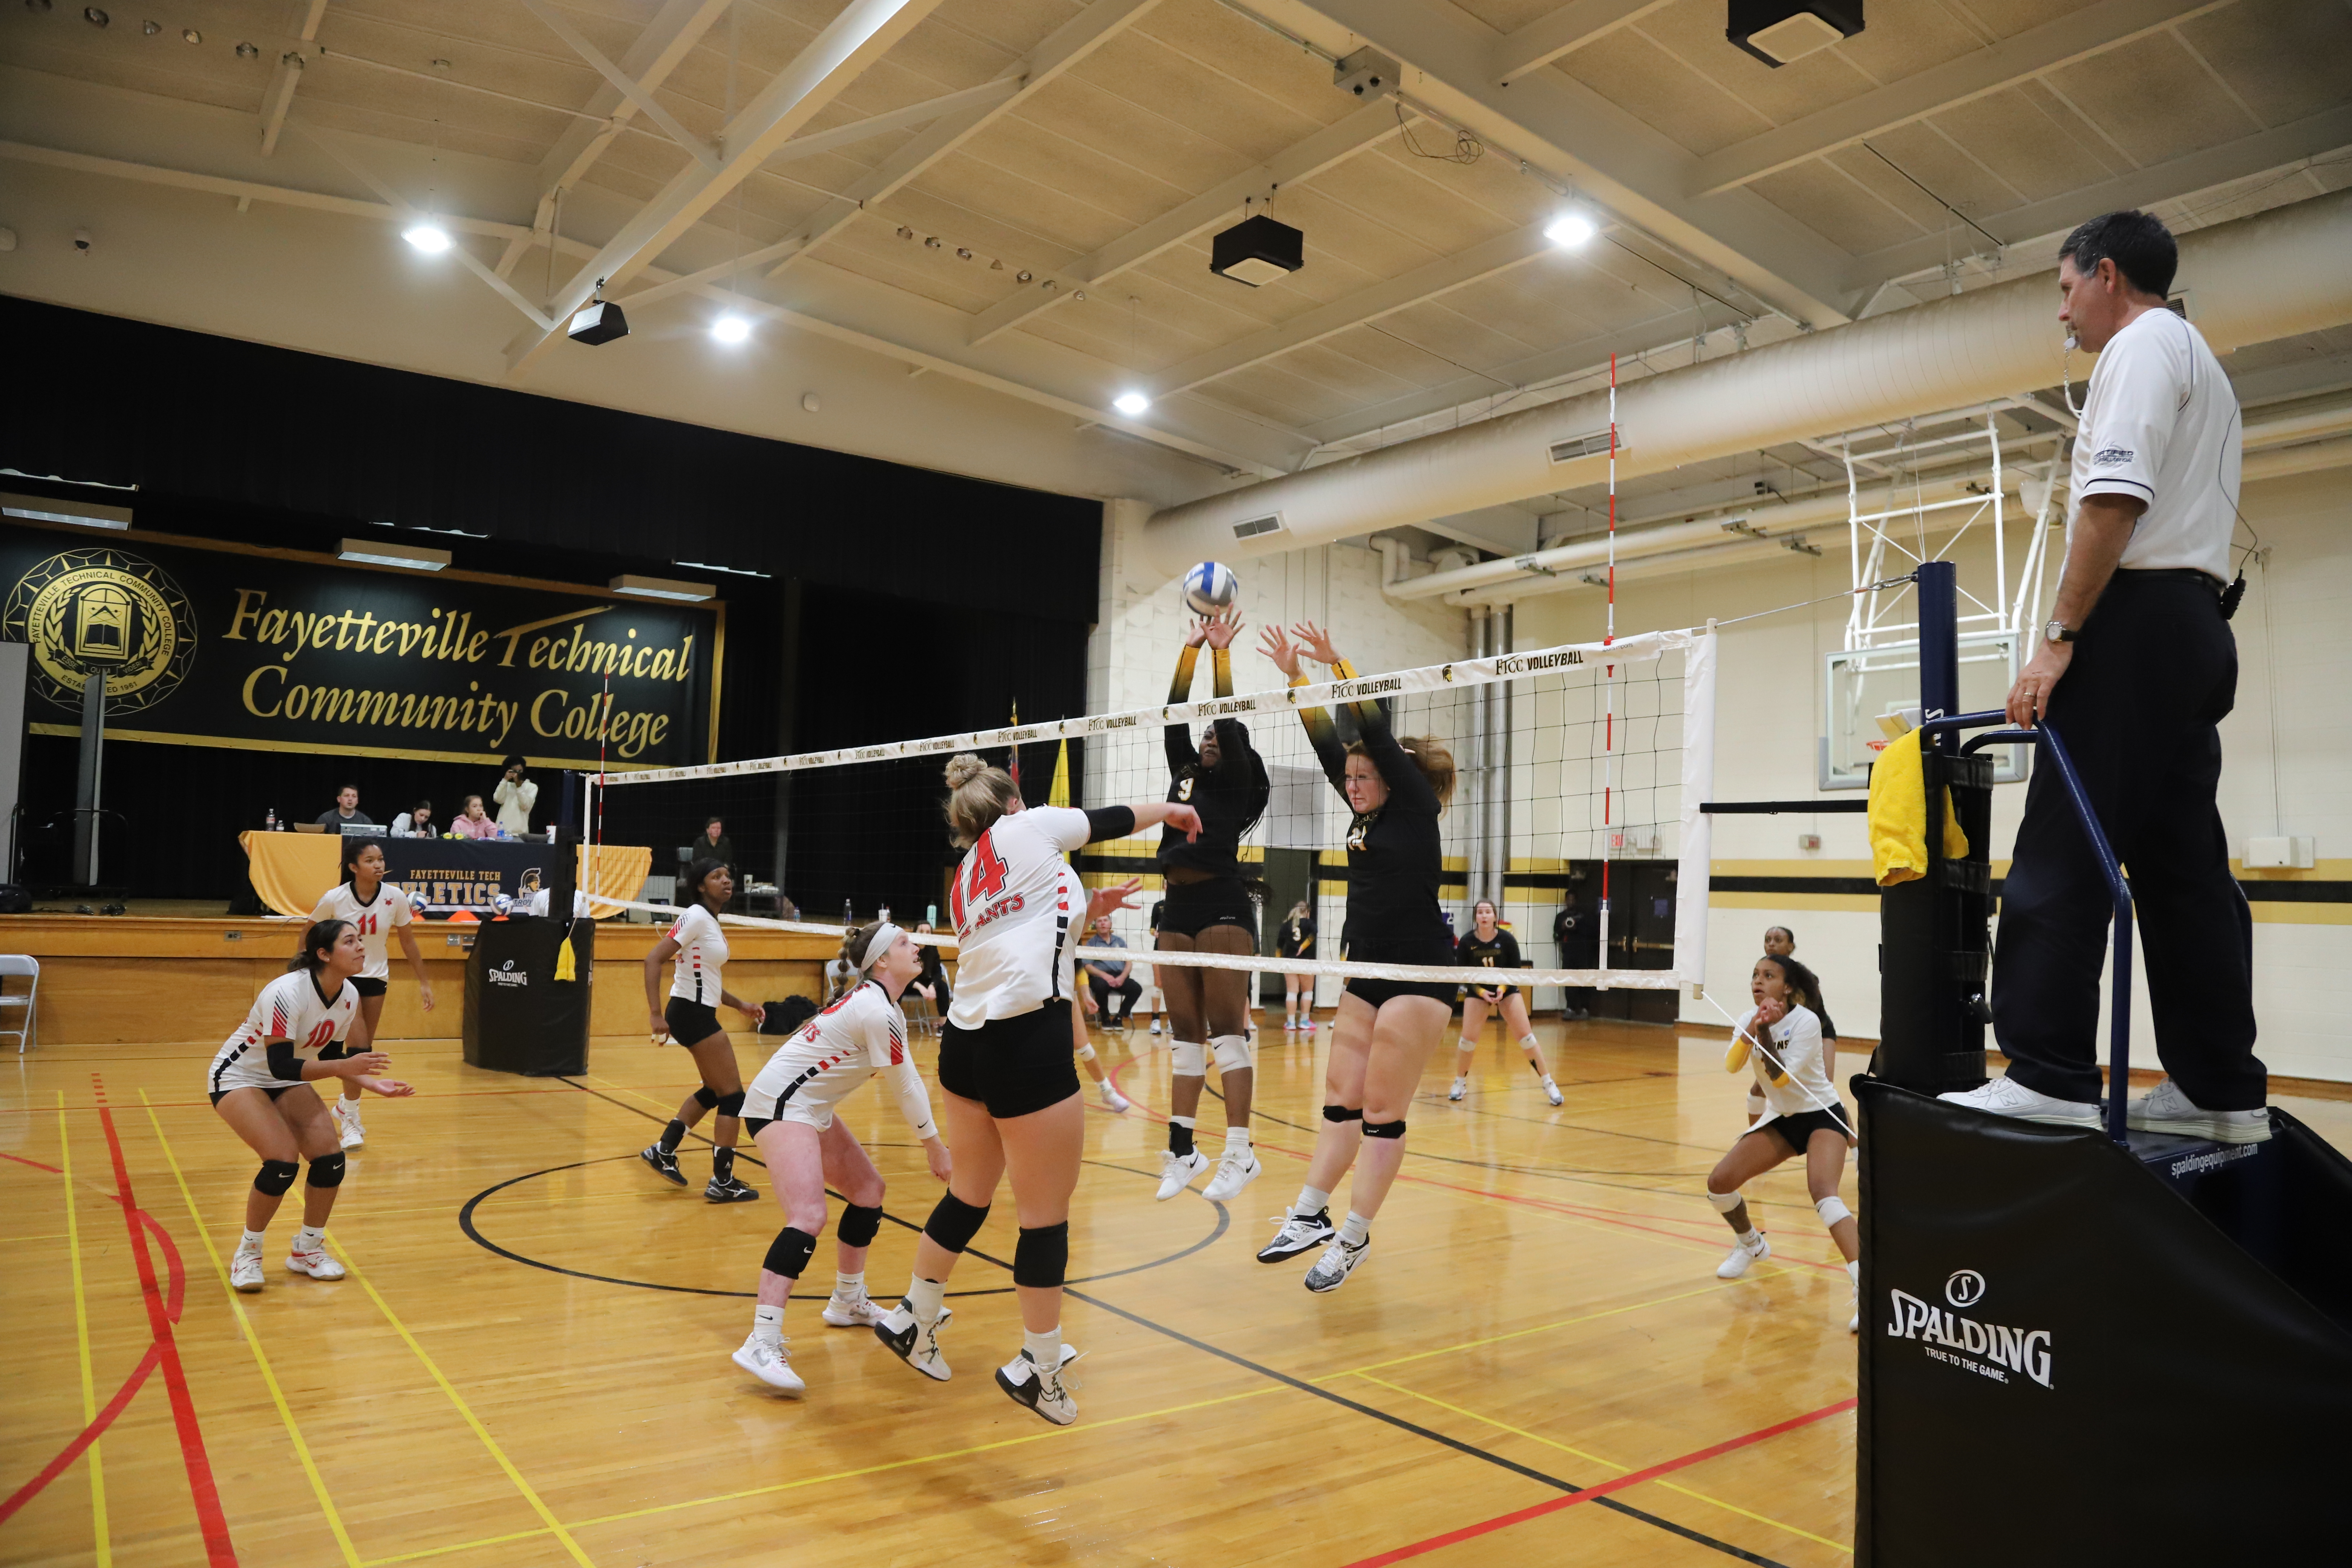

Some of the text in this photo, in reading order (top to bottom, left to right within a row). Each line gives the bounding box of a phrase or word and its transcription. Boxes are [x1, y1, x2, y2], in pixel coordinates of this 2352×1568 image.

[32, 571, 173, 656] FAYETTEVILLE TECHNICAL COMMUNITY COLLEGE
[222, 588, 692, 681] Fayetteville Technical
[61, 655, 78, 668] ESSE
[122, 661, 142, 674] VIDERI
[1496, 651, 1583, 675] FTCC VOLLEYBALL
[120, 681, 138, 691] 1961
[1331, 678, 1401, 699] FTCC VOLLEYBALL
[242, 665, 668, 758] Community College
[1198, 699, 1256, 716] FTCC VOLLEYBALL
[1089, 716, 1136, 731] FTCC VOLLEYBALL
[933, 740, 954, 750] VOLLEYBALL
[998, 729, 1037, 742] FTCC VOLLEYBALL
[1178, 778, 1194, 801] 9
[1611, 834, 1624, 847] EXIT
[410, 870, 501, 881] FAYETTEVILLE TECH
[950, 828, 1009, 933] 14
[975, 892, 1024, 929] ANTS
[357, 913, 377, 935] 11
[1292, 927, 1301, 941] 3
[1482, 956, 1494, 967] 11
[489, 968, 527, 986] SPALDING
[301, 1019, 335, 1049] 10
[2171, 1143, 2258, 1179] spaldingequipment.com
[1888, 1288, 2051, 1387] SPALDING
[1925, 1347, 2004, 1382] TRUE TO THE GAME
